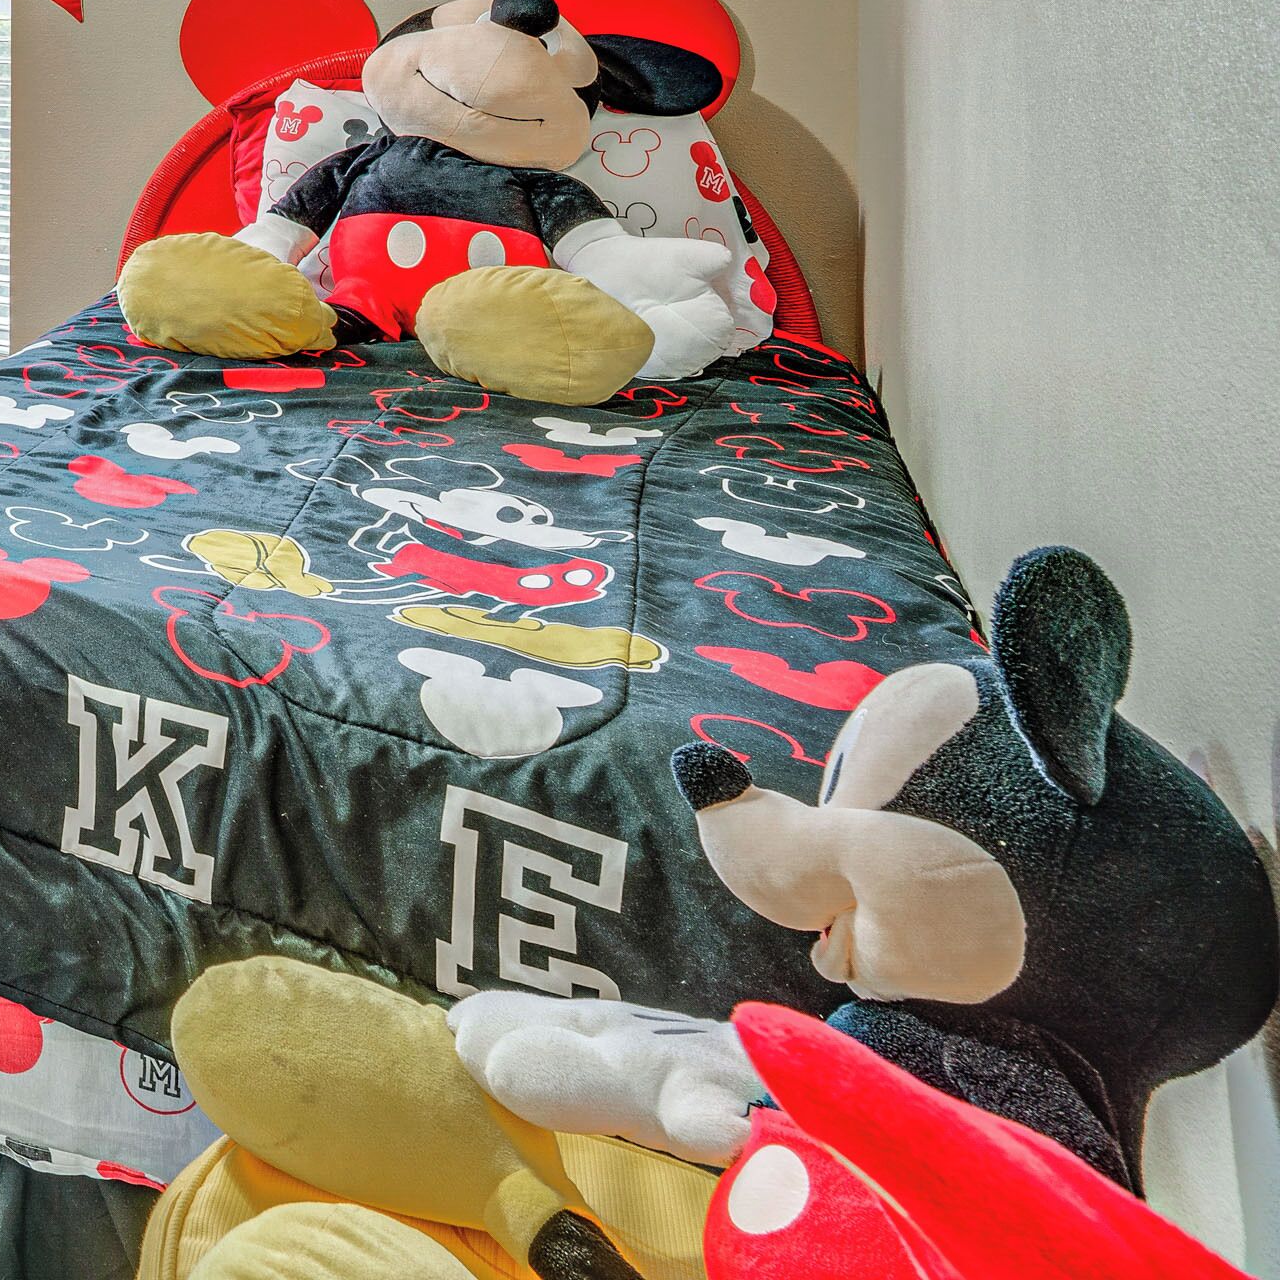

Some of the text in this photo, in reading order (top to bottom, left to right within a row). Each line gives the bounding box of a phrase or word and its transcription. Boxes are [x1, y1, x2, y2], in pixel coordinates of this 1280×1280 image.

[280, 117, 302, 135] M
[700, 166, 726, 195] M
[139, 1053, 181, 1099] M
